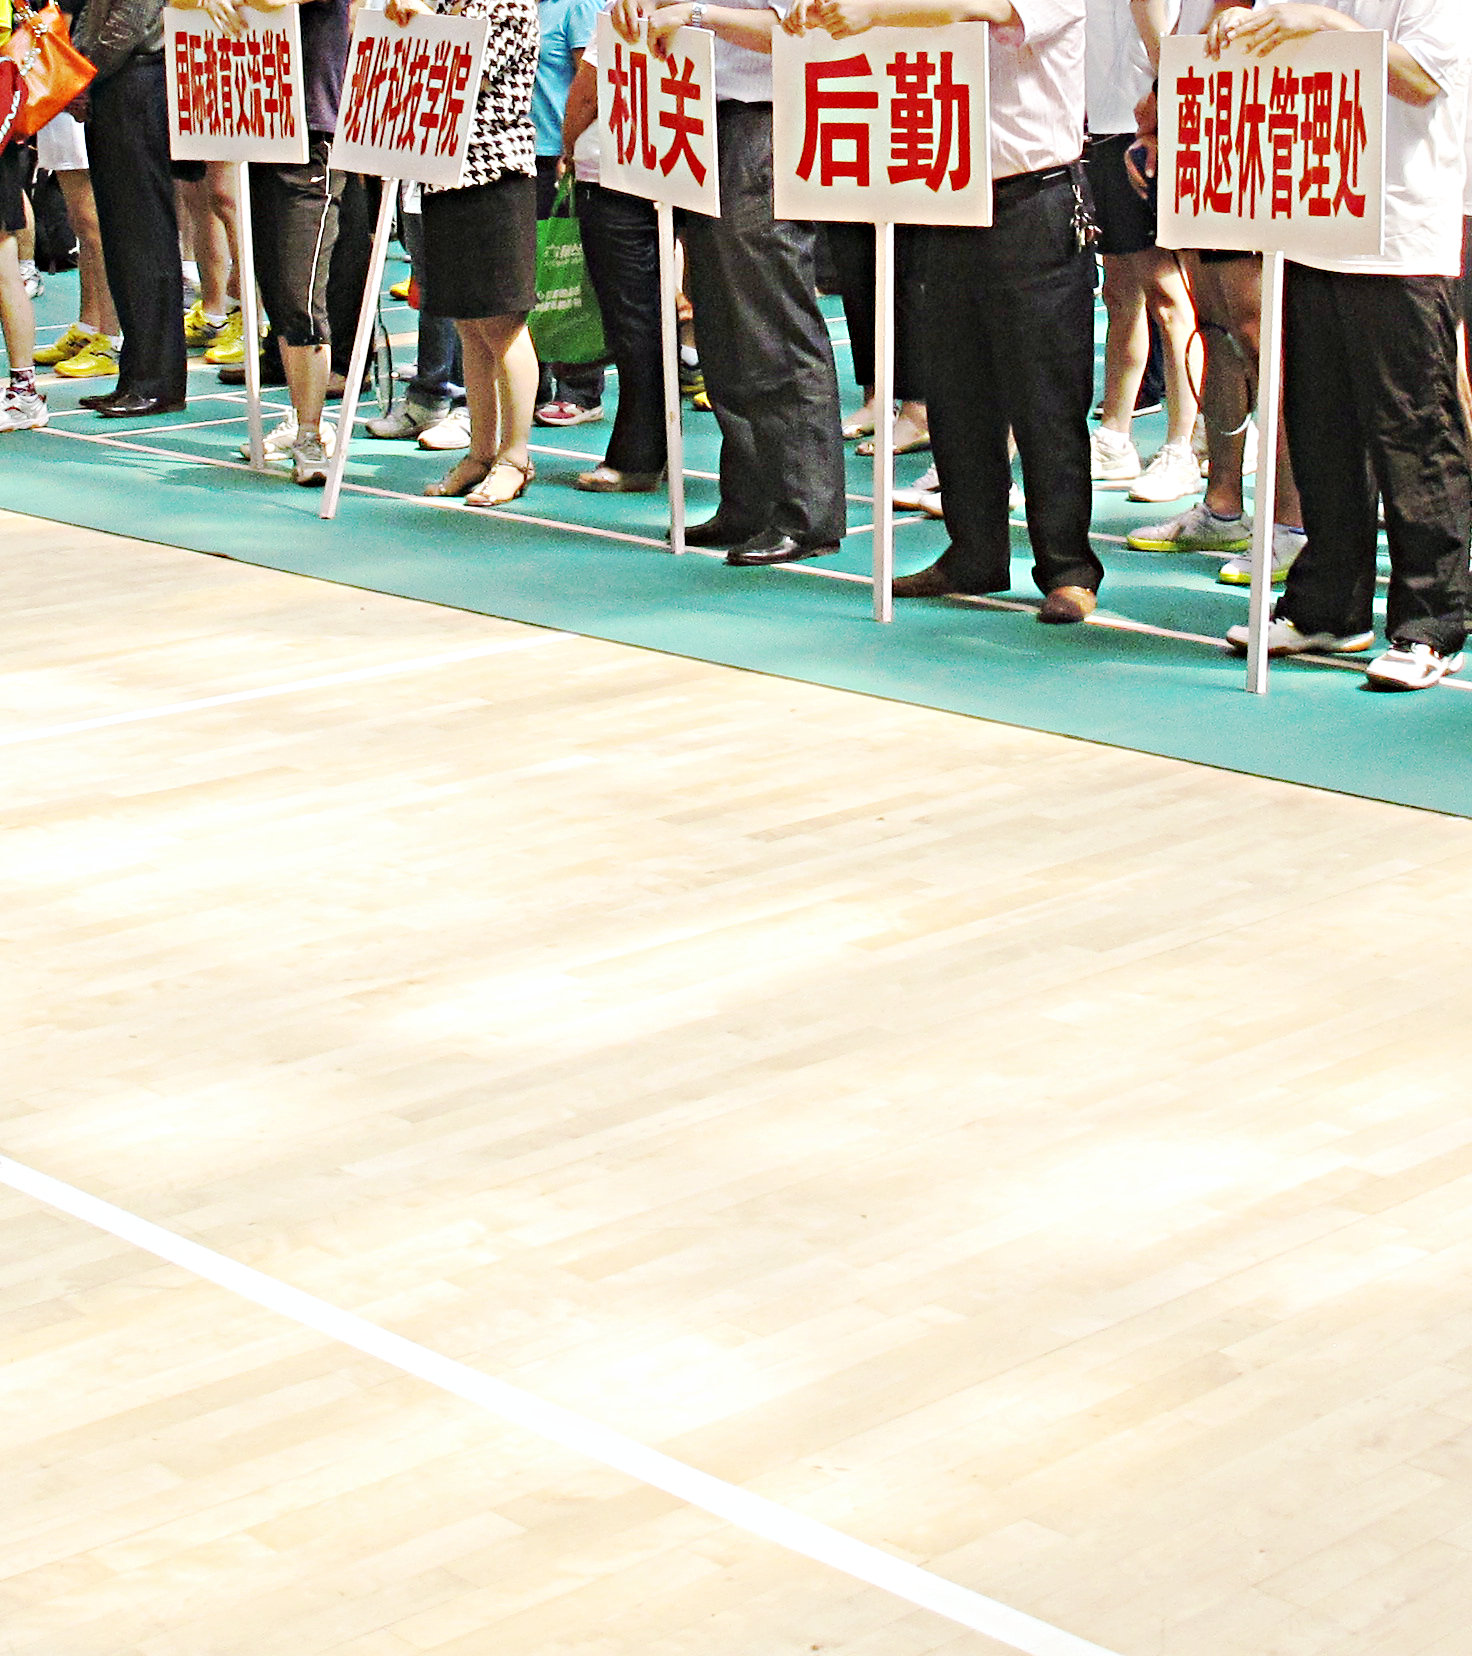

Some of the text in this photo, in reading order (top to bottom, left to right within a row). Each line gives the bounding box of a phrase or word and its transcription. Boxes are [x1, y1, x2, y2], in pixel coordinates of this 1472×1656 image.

[175, 29, 295, 140] 国际教育交流学院
[344, 32, 473, 157] 现代科技学院
[607, 42, 707, 187] 机关
[795, 51, 971, 193] 后勤
[1174, 65, 1367, 220] 离退休管理处
